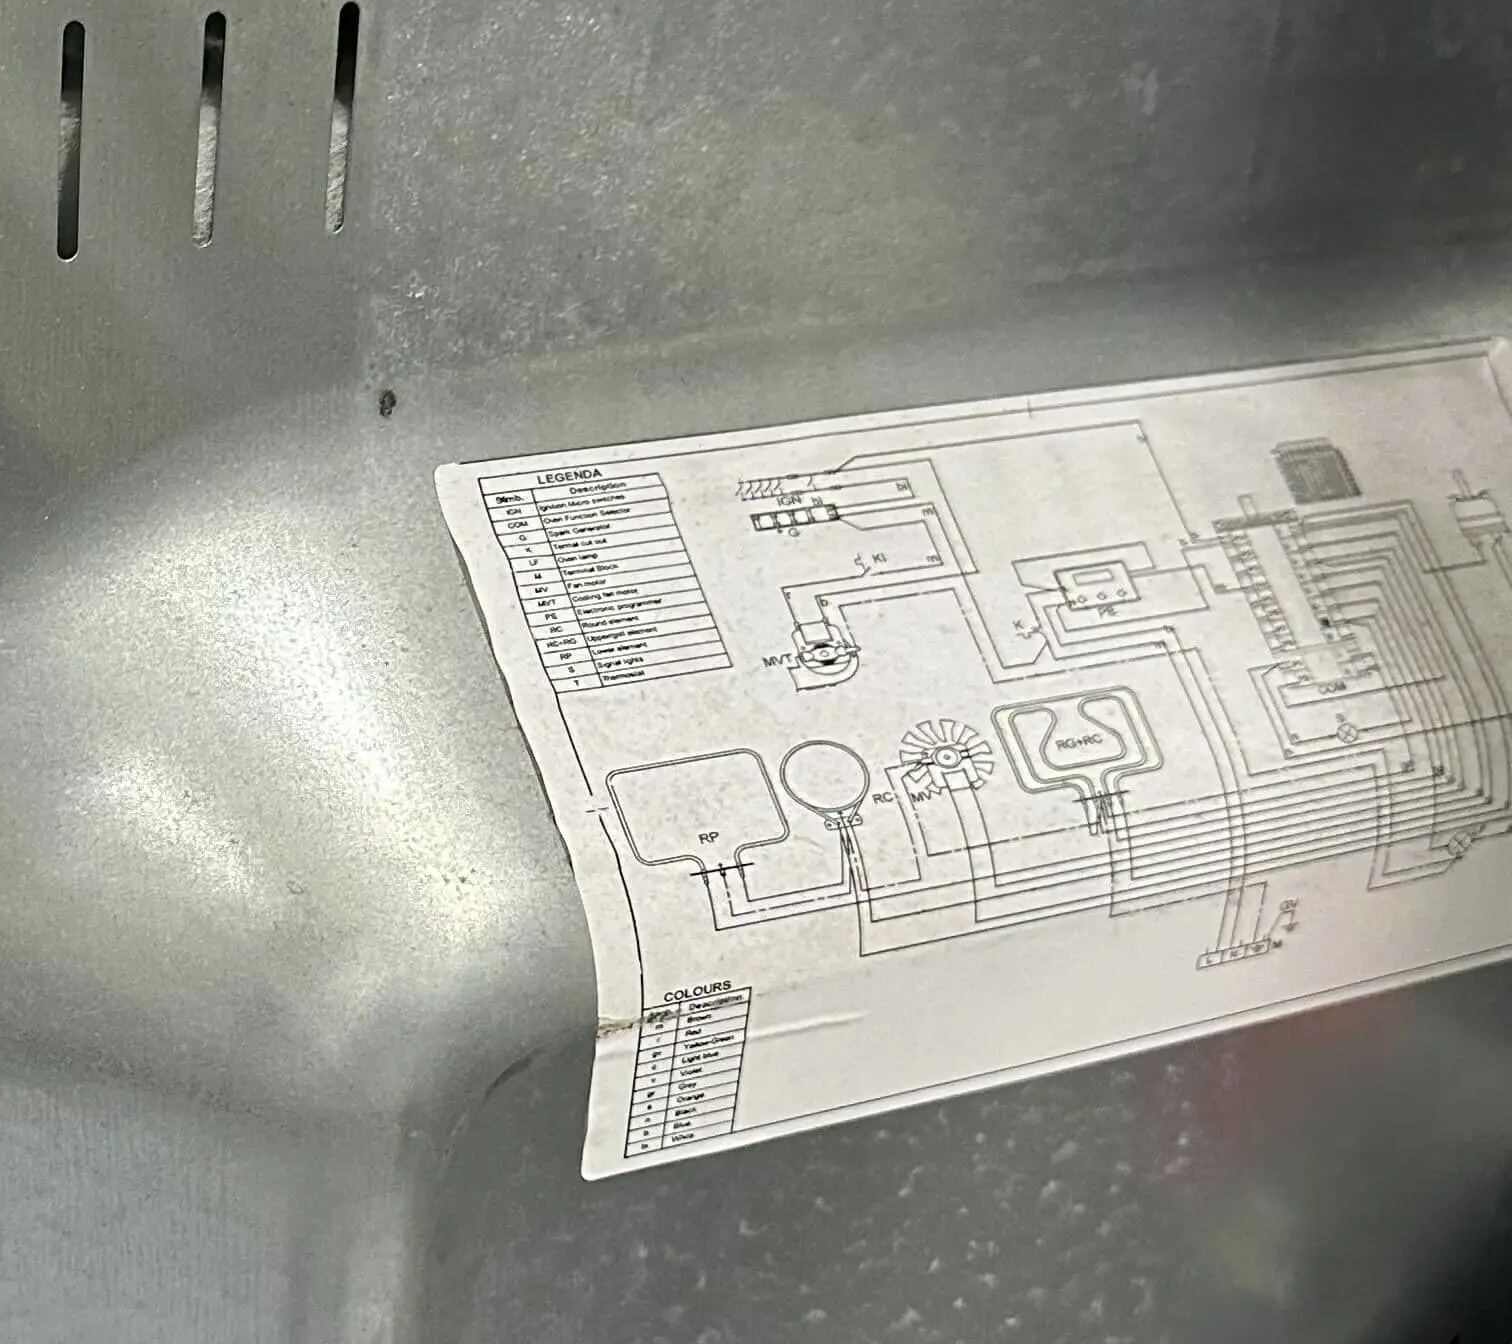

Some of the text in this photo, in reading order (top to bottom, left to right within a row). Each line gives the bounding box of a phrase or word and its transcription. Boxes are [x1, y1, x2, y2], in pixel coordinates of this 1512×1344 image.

[536, 468, 603, 485] LEGENDA
[698, 831, 720, 845] RP
[663, 979, 733, 1003] COLOURS
